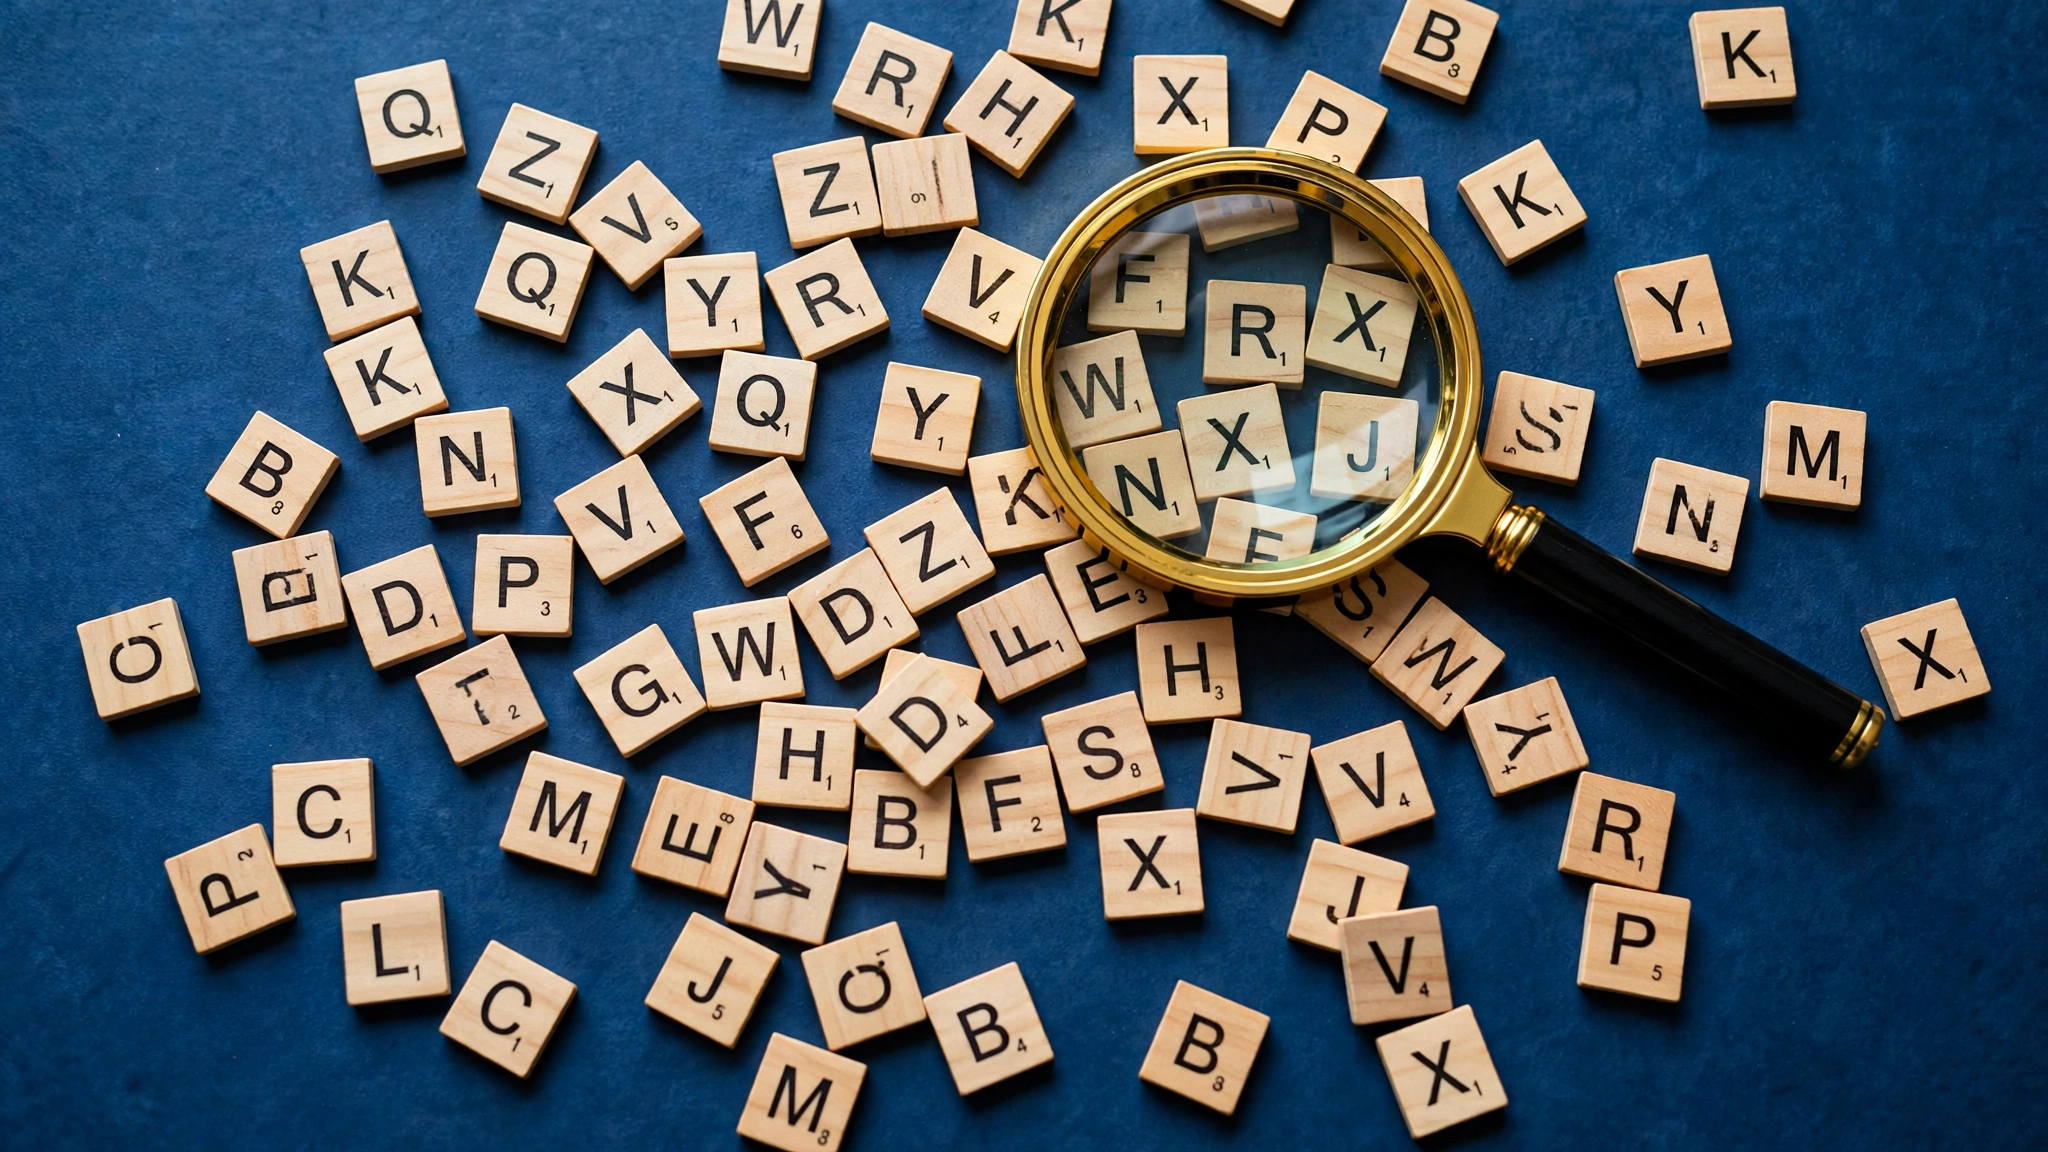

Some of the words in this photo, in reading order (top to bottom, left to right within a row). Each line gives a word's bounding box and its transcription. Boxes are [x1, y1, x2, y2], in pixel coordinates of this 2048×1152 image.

[743, 0, 805, 48] W
[793, 43, 800, 57] 1
[1035, 0, 1082, 44] K
[1076, 37, 1085, 52] 1
[1413, 9, 1461, 63] B
[864, 49, 917, 108] R
[905, 104, 915, 119] 1
[1720, 29, 1768, 80] K
[1768, 69, 1778, 84] 1
[382, 88, 435, 139] Q
[435, 124, 444, 138] 1
[978, 78, 1040, 138] H
[1011, 136, 1024, 149] 1
[1156, 76, 1200, 126] X
[1200, 117, 1210, 132] 1
[1296, 97, 1349, 144] P
[507, 130, 562, 189] Z
[544, 183, 555, 199] 1
[802, 162, 850, 219] Z
[851, 201, 862, 216] 1
[600, 192, 653, 244] V
[1492, 170, 1553, 230] K
[1552, 203, 1565, 216] 1
[331, 249, 385, 308] K
[385, 286, 396, 300] 1
[506, 251, 558, 311] Q
[547, 303, 557, 317] 1
[686, 275, 731, 328] Y
[730, 318, 740, 333] 1
[795, 272, 856, 329] R
[855, 303, 867, 317] 1
[968, 253, 1016, 309] V
[1115, 253, 1155, 303] F
[1155, 299, 1164, 314] 1
[1644, 279, 1689, 334] Y
[1696, 320, 1707, 336] 1
[987, 311, 1001, 325] 4
[1230, 302, 1278, 360] R
[1278, 351, 1287, 367] 1
[1332, 291, 1388, 353] X
[1378, 346, 1388, 363] 1
[354, 346, 413, 407] K
[411, 382, 423, 396] 1
[598, 361, 663, 427] X
[662, 390, 675, 402] 1
[736, 373, 786, 432] Q
[783, 422, 791, 438] 1
[1060, 356, 1125, 419] W
[1132, 399, 1143, 414] 1
[905, 386, 950, 441] Y
[936, 436, 945, 452] 1
[1206, 411, 1261, 473] X
[1262, 455, 1272, 470] 1
[238, 440, 294, 499] B
[270, 500, 285, 516] 8
[439, 430, 487, 487] N
[489, 472, 498, 488] 1
[1347, 421, 1378, 473] J
[1383, 466, 1391, 482] 1
[1786, 424, 1841, 482] M
[1839, 474, 1849, 490] 1
[584, 484, 634, 542] V
[645, 520, 658, 534] 1
[998, 466, 1051, 525] K
[1115, 457, 1167, 517] N
[1170, 500, 1181, 517] 1
[1665, 483, 1716, 544] N
[732, 490, 775, 552] F
[789, 524, 805, 540] 6
[304, 551, 318, 562] 1
[898, 520, 958, 583] Z
[958, 554, 972, 569] 1
[1076, 545, 1130, 613] E
[1135, 588, 1148, 604] 3
[371, 579, 424, 637] D
[428, 612, 440, 628] 1
[497, 555, 540, 608] P
[539, 600, 552, 617] 3
[147, 621, 163, 632] 1
[818, 587, 875, 646] D
[882, 615, 894, 629] 1
[1363, 626, 1374, 638] 1
[710, 621, 776, 682] W
[778, 665, 788, 681] 1
[989, 625, 1052, 668] F
[1053, 639, 1066, 653] 1
[1163, 641, 1211, 697] H
[1213, 685, 1225, 701] 3
[1896, 628, 1957, 691] X
[1956, 667, 1969, 684] 1
[506, 704, 522, 720] 2
[611, 663, 670, 718] G
[670, 691, 683, 705] 1
[1441, 692, 1454, 706] 1
[888, 696, 948, 754] D
[955, 714, 970, 728] 4
[1077, 725, 1125, 781] S
[1128, 762, 1143, 778] 8
[1494, 722, 1553, 762] Y
[1535, 711, 1550, 723] 1
[778, 727, 826, 783] H
[825, 774, 833, 791] 1
[1224, 750, 1282, 796] V
[1339, 750, 1385, 809] V
[1397, 792, 1412, 808] 4
[296, 784, 344, 840] C
[343, 828, 352, 844] 1
[528, 779, 593, 845] M
[579, 839, 589, 855] 1
[873, 794, 918, 851] B
[918, 844, 926, 860] 1
[983, 774, 1022, 833] F
[1029, 815, 1044, 833] 2
[660, 813, 723, 865] E
[718, 812, 736, 825] 8
[1591, 798, 1642, 862] R
[1636, 855, 1646, 872] 1
[199, 872, 260, 918] P
[236, 848, 255, 862] 2
[753, 858, 812, 900] Y
[812, 862, 827, 872] 1
[1123, 835, 1172, 892] X
[1173, 880, 1183, 896] 1
[1325, 875, 1366, 925] J
[371, 922, 410, 978] L
[413, 964, 422, 981] 1
[875, 947, 889, 958] 1
[1367, 935, 1415, 995] V
[1417, 981, 1431, 998] 4
[1609, 911, 1657, 966] P
[1650, 964, 1664, 982] 5
[687, 955, 734, 1004] J
[480, 979, 533, 1036] C
[510, 1037, 523, 1053] 1
[710, 1003, 726, 1021] 5
[956, 1002, 1010, 1063] B
[1173, 1012, 1225, 1075] B
[1410, 1039, 1471, 1107] X
[767, 1063, 834, 1134] M
